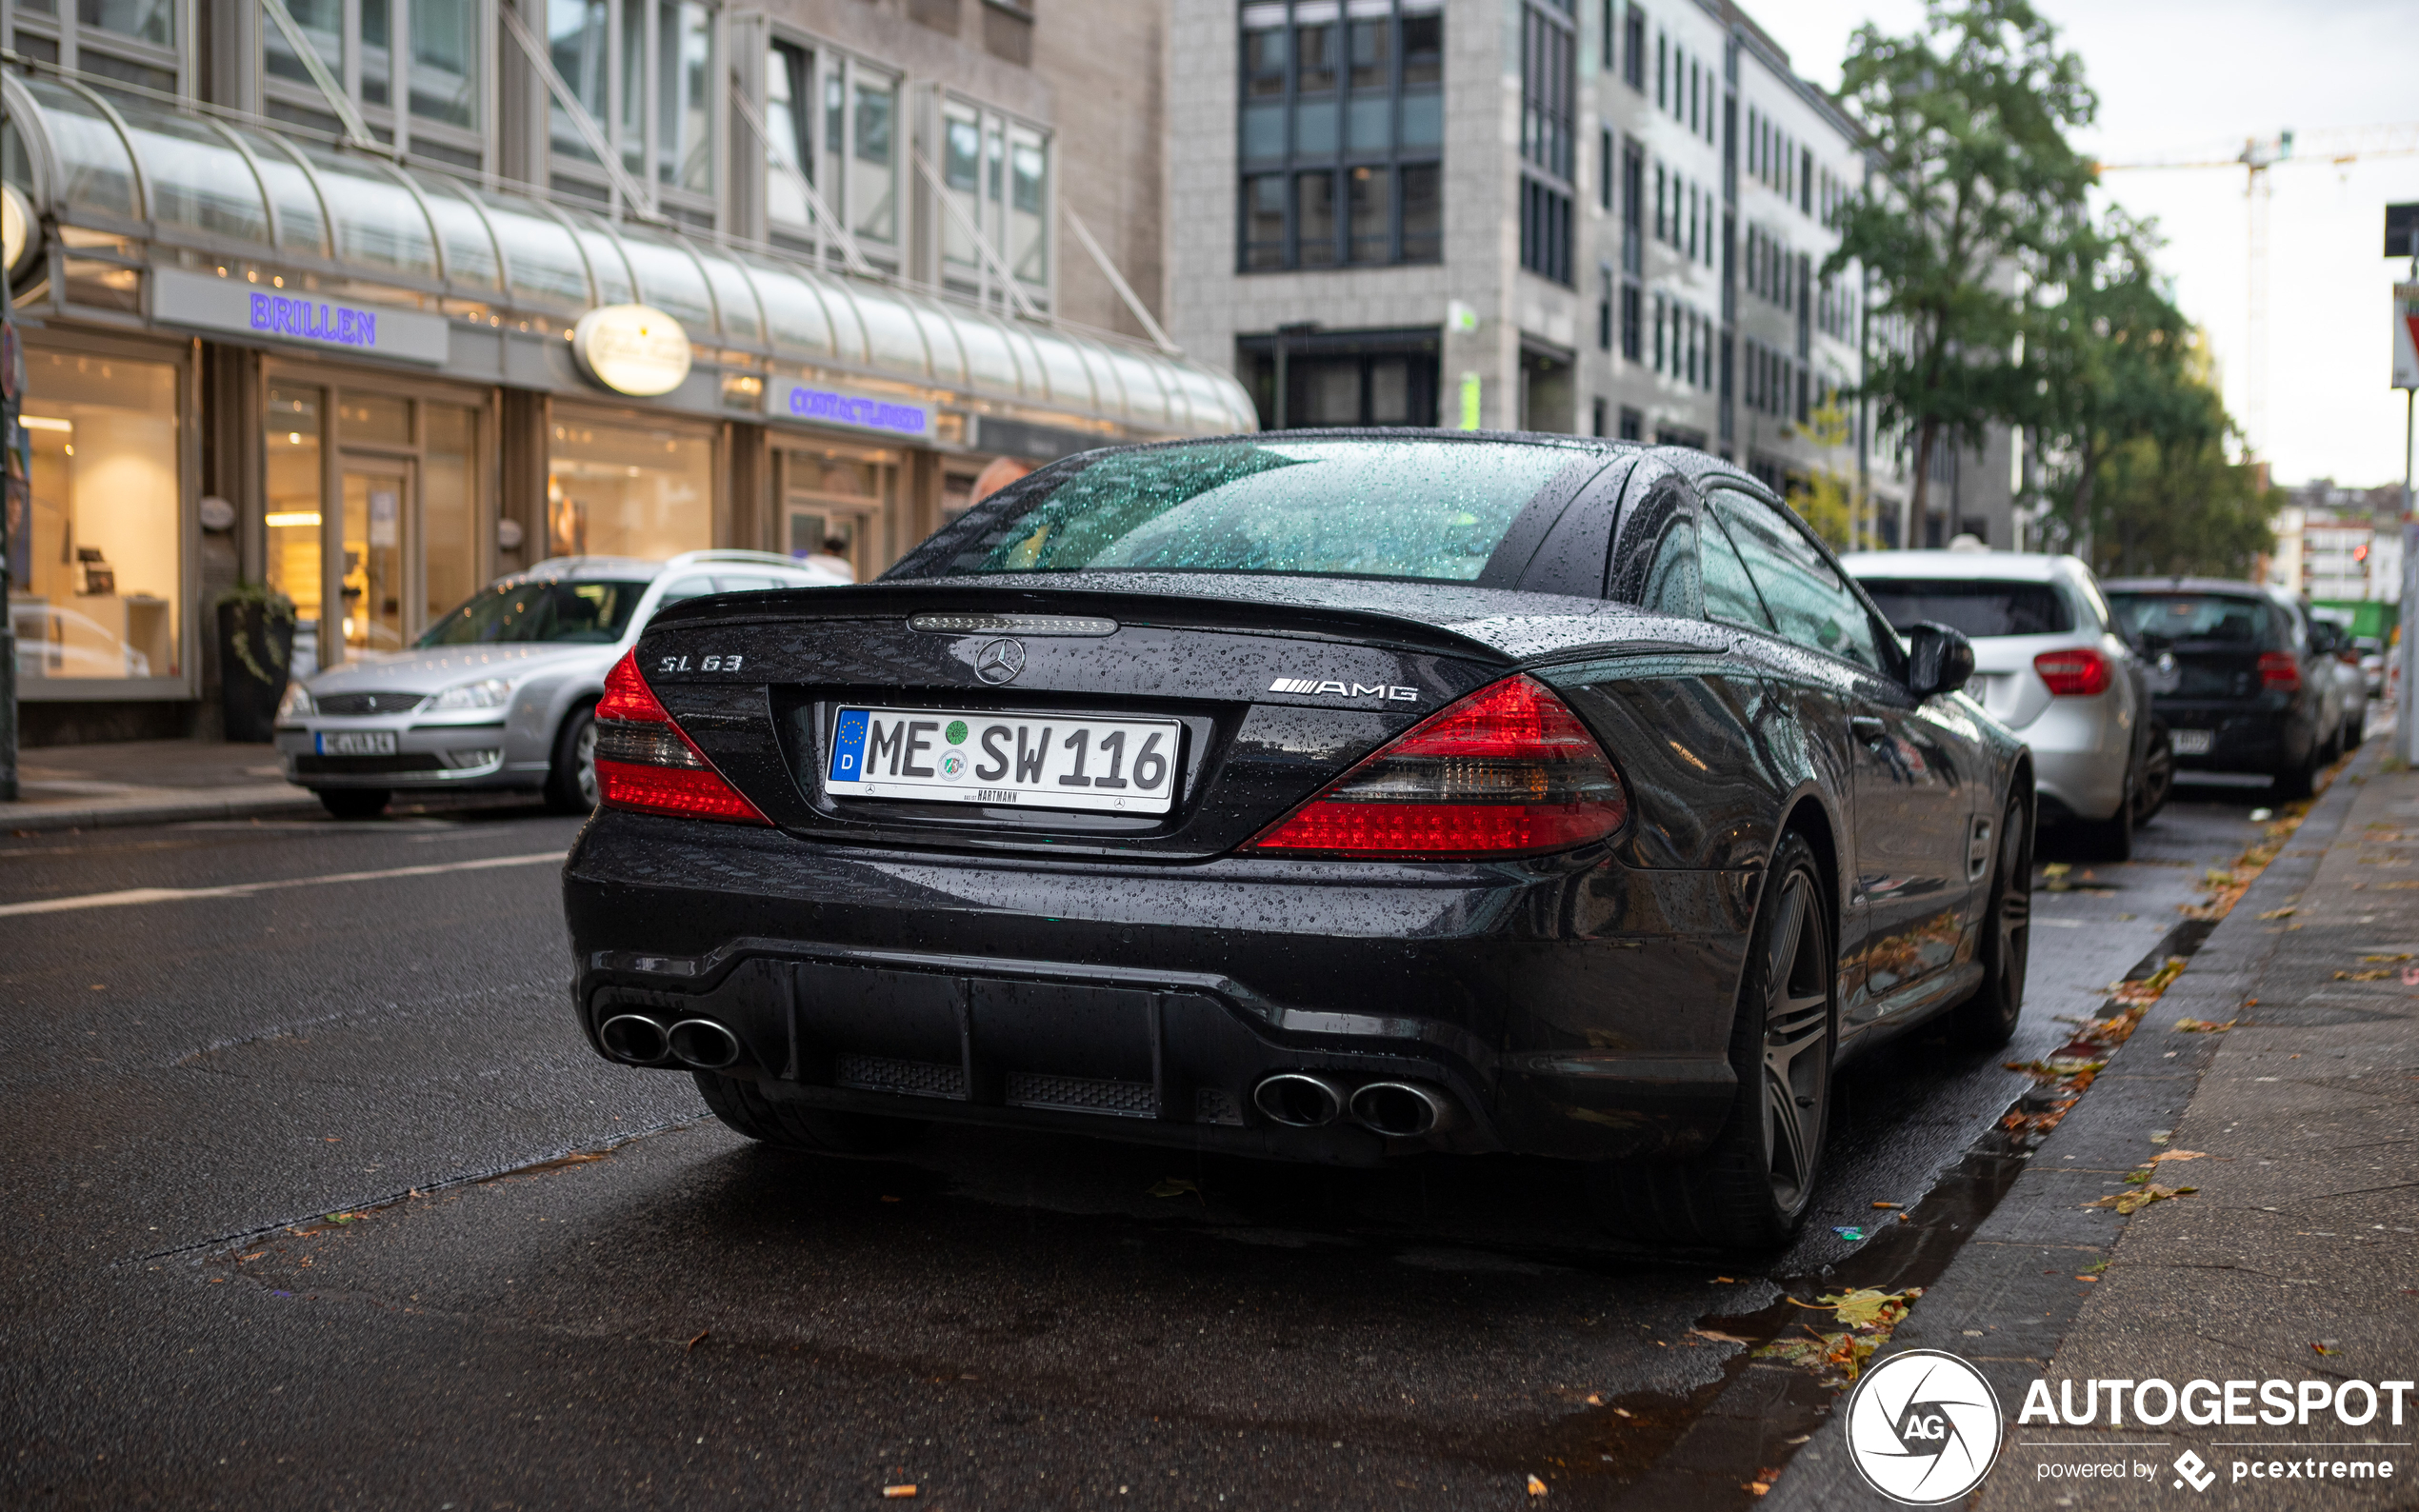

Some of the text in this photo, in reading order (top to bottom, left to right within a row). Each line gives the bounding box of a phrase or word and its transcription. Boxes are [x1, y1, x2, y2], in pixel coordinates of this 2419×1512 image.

[250, 291, 376, 347] BRILLEN
[658, 654, 743, 672] SL 63
[1313, 681, 1419, 702] AMG
[841, 754, 853, 769] D
[867, 720, 939, 777] ME
[975, 726, 1051, 784] SW
[1059, 729, 1167, 789] 116
[977, 789, 1018, 804] HARTMANN
